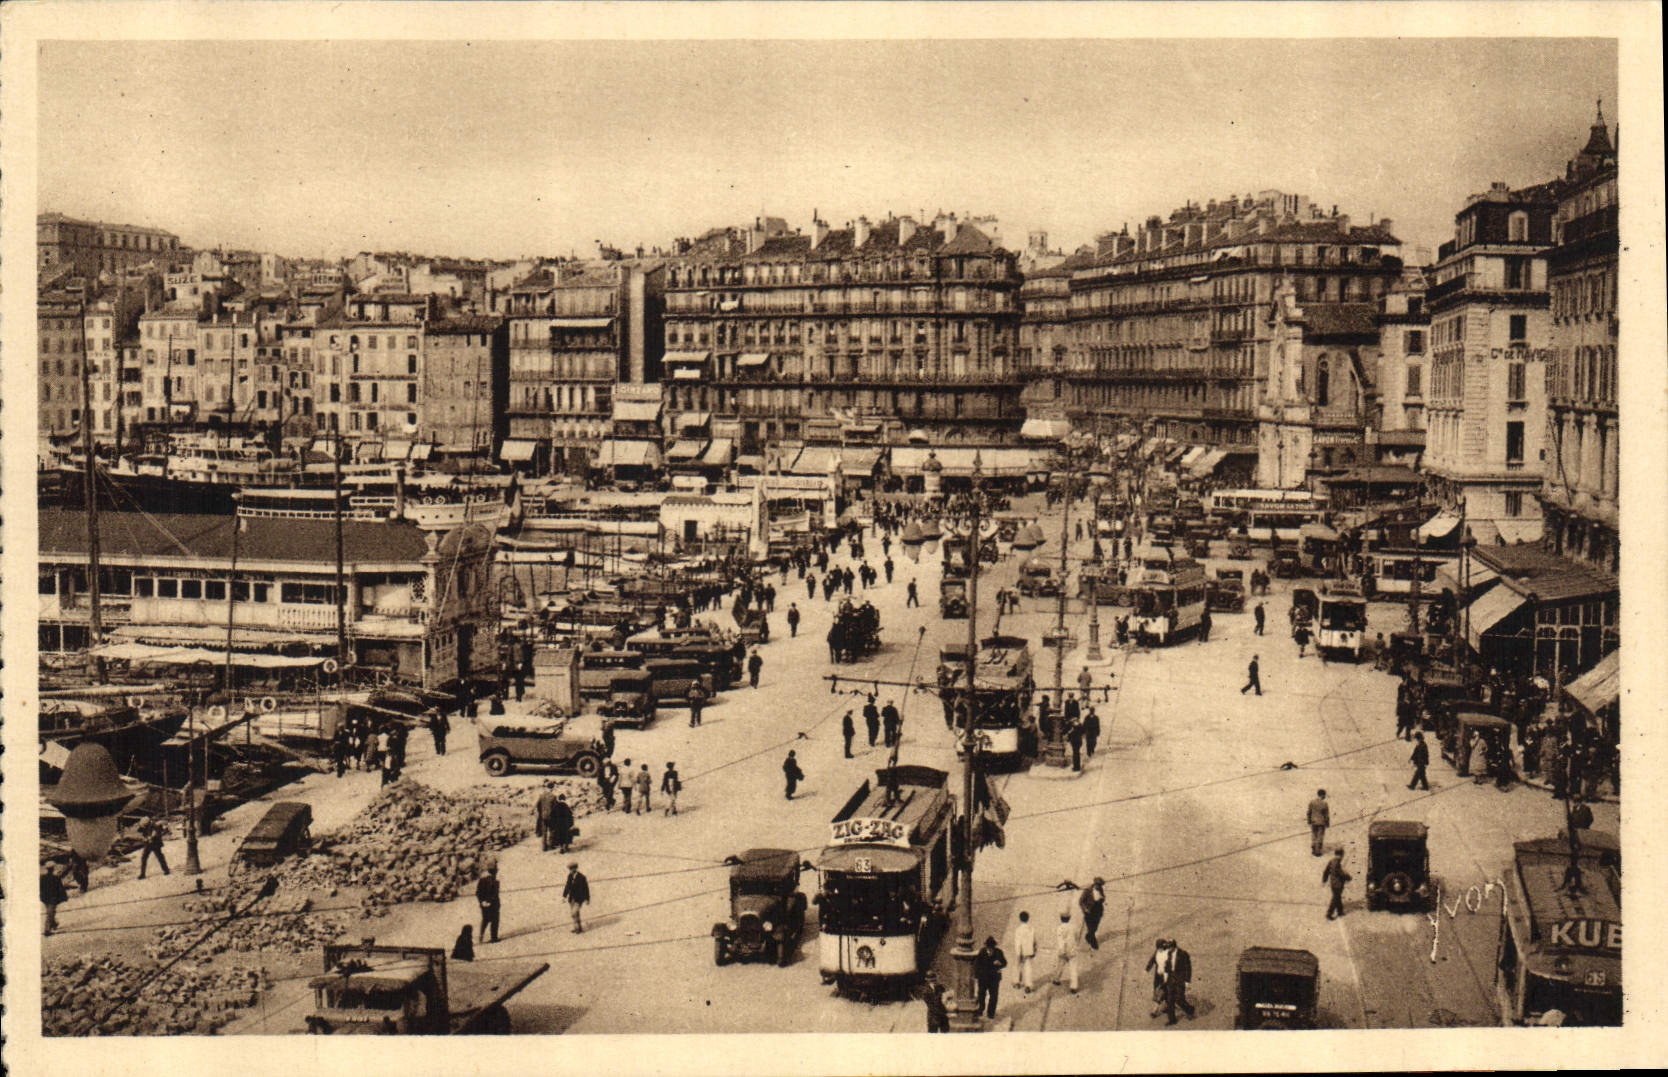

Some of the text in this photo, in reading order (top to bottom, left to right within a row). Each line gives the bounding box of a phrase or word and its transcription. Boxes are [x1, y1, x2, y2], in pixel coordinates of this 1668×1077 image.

[168, 276, 198, 284] SUZE
[833, 820, 904, 840] ZIG-ZAG
[856, 859, 872, 872] 63
